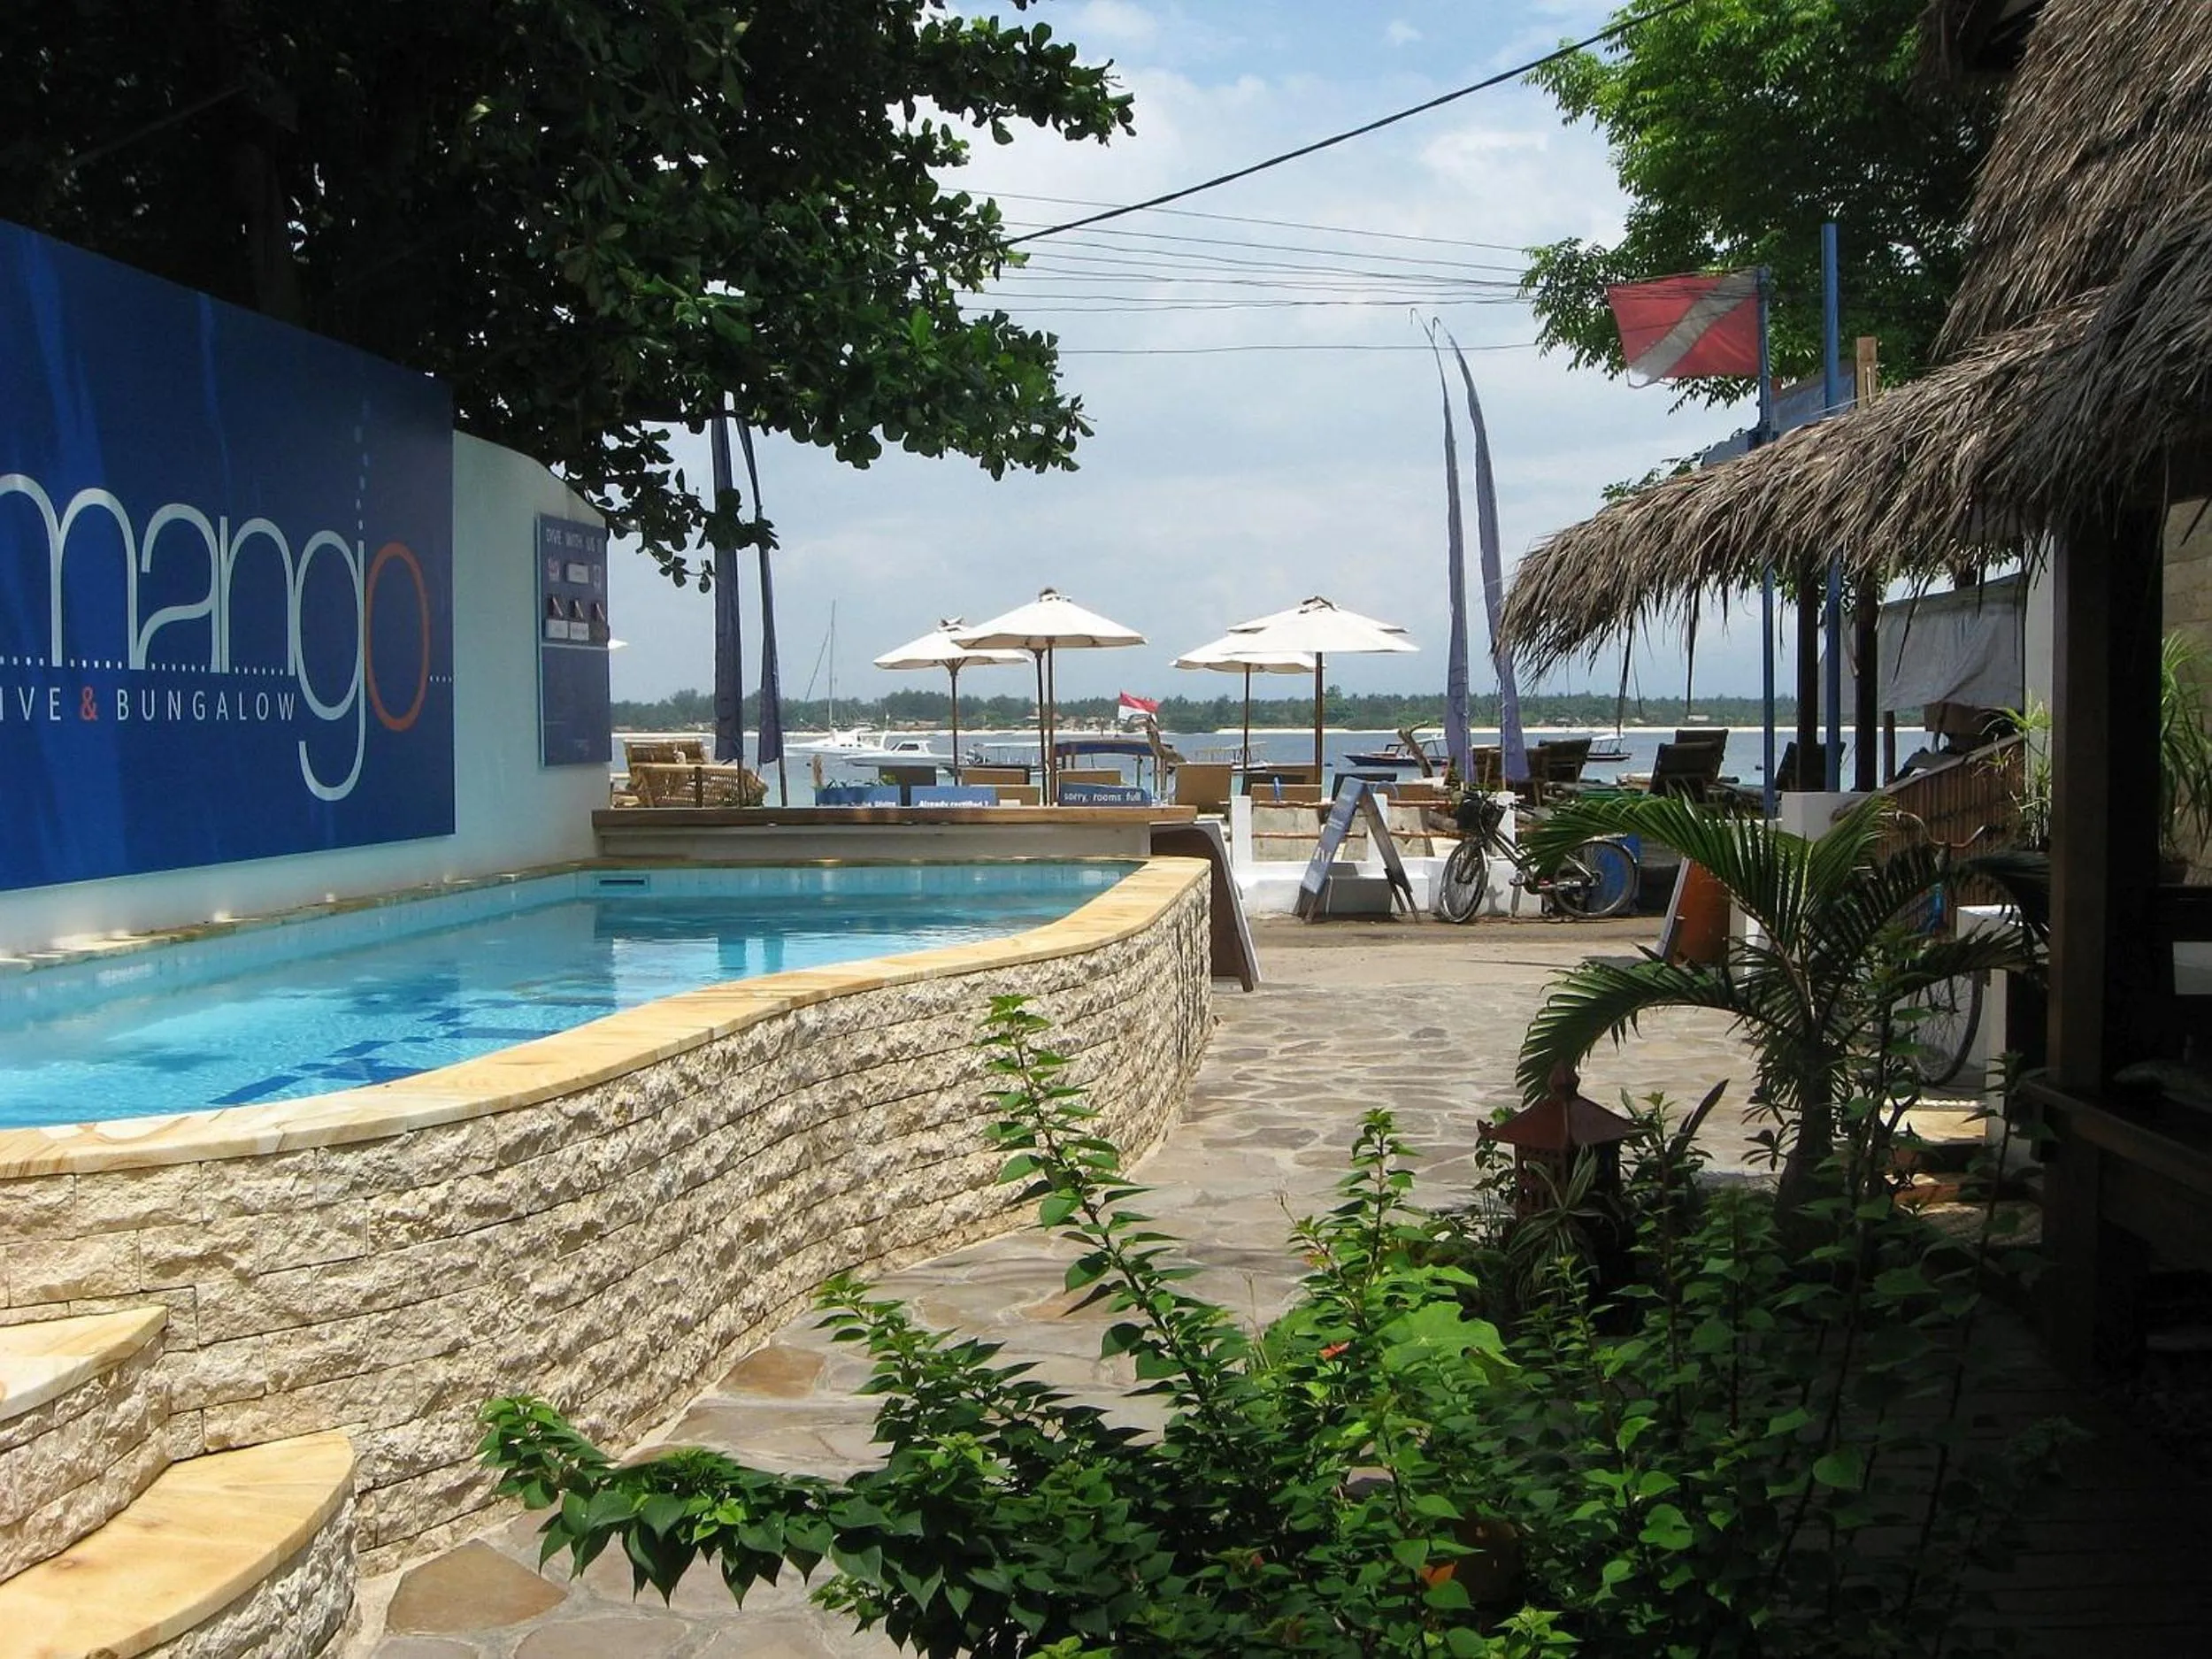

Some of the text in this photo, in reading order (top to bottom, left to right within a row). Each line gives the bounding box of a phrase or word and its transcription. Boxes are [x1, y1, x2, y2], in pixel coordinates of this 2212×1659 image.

[0, 473, 430, 802] mango
[80, 687, 97, 720] &
[118, 689, 295, 720] BUNGALOW
[1093, 793, 1122, 802] rooms
[1125, 790, 1141, 802] full
